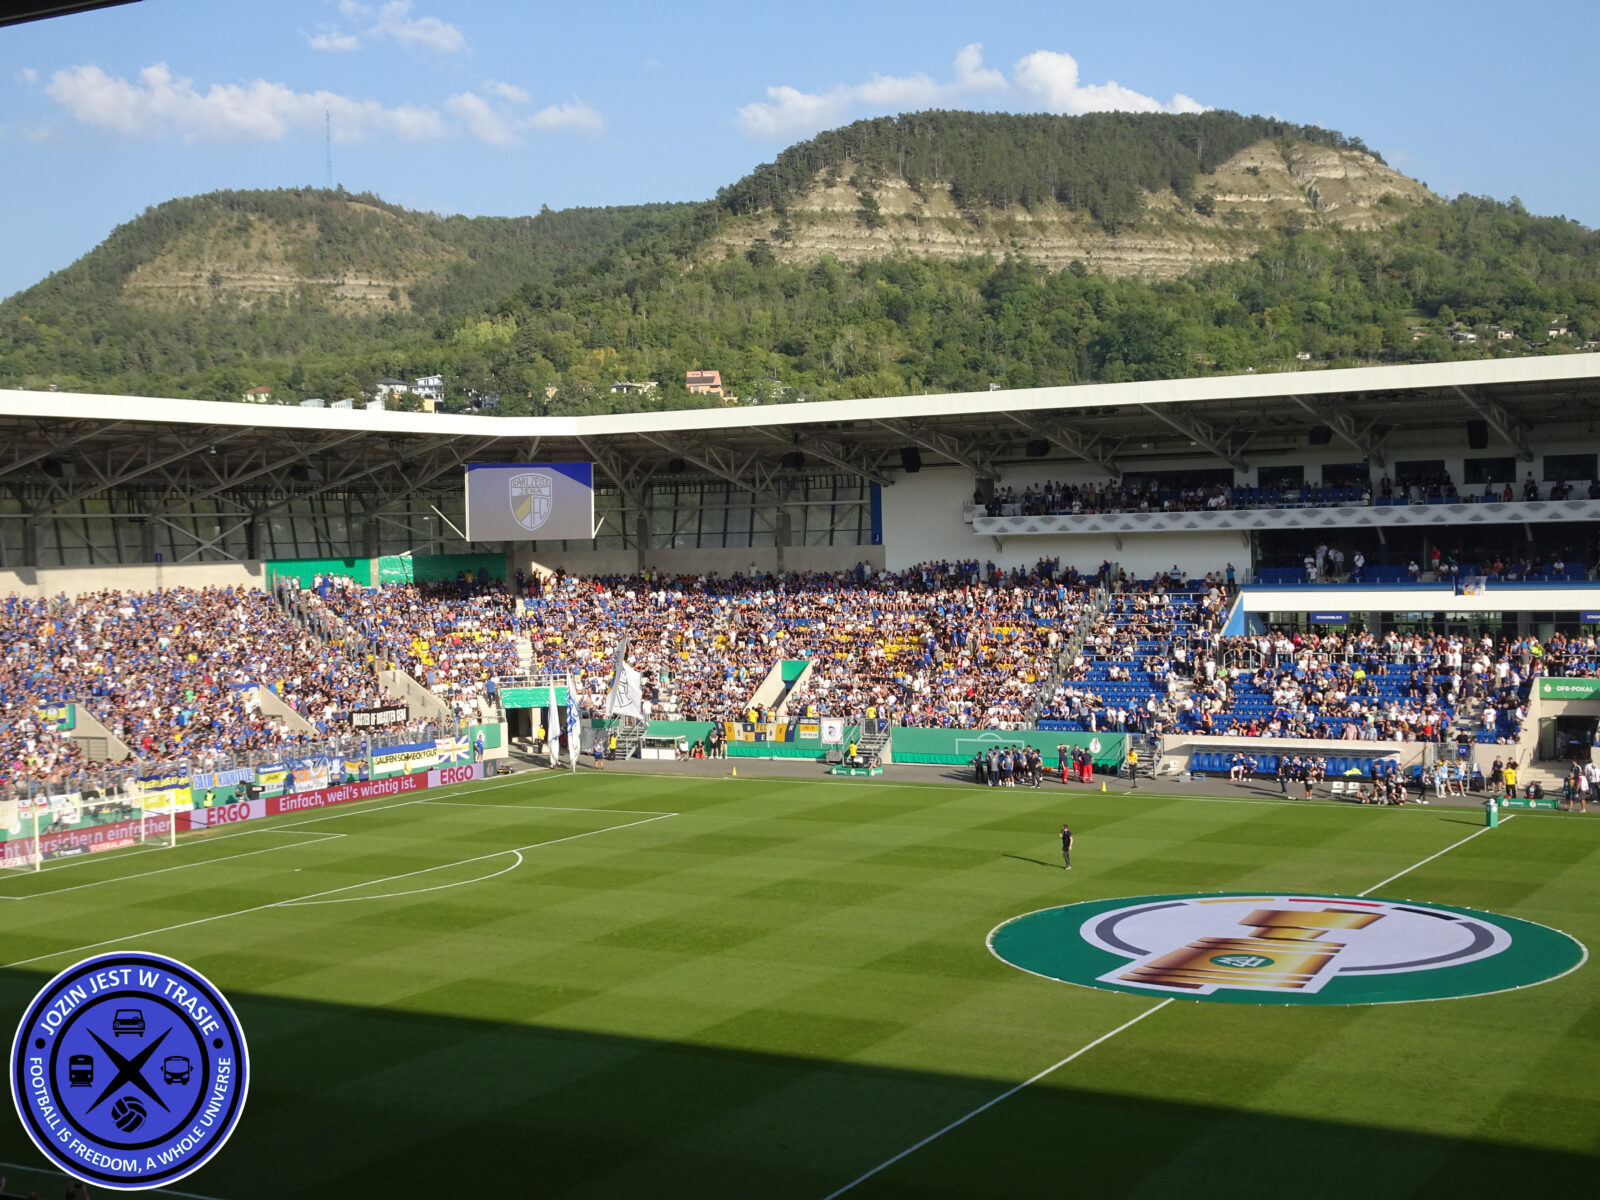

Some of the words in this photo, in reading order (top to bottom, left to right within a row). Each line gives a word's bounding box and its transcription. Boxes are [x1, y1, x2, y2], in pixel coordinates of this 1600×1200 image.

[531, 476, 550, 487] ZEISS
[352, 712, 370, 726] MASTER
[370, 712, 376, 726] OF
[374, 756, 398, 766] SAUFEN
[440, 764, 474, 785] ERGO
[279, 792, 325, 812] Einfach,
[326, 786, 358, 803] weil's
[360, 779, 399, 797] wichtig
[401, 777, 417, 790] ist.
[207, 802, 251, 826] ERGO
[24, 829, 104, 856] Versichern
